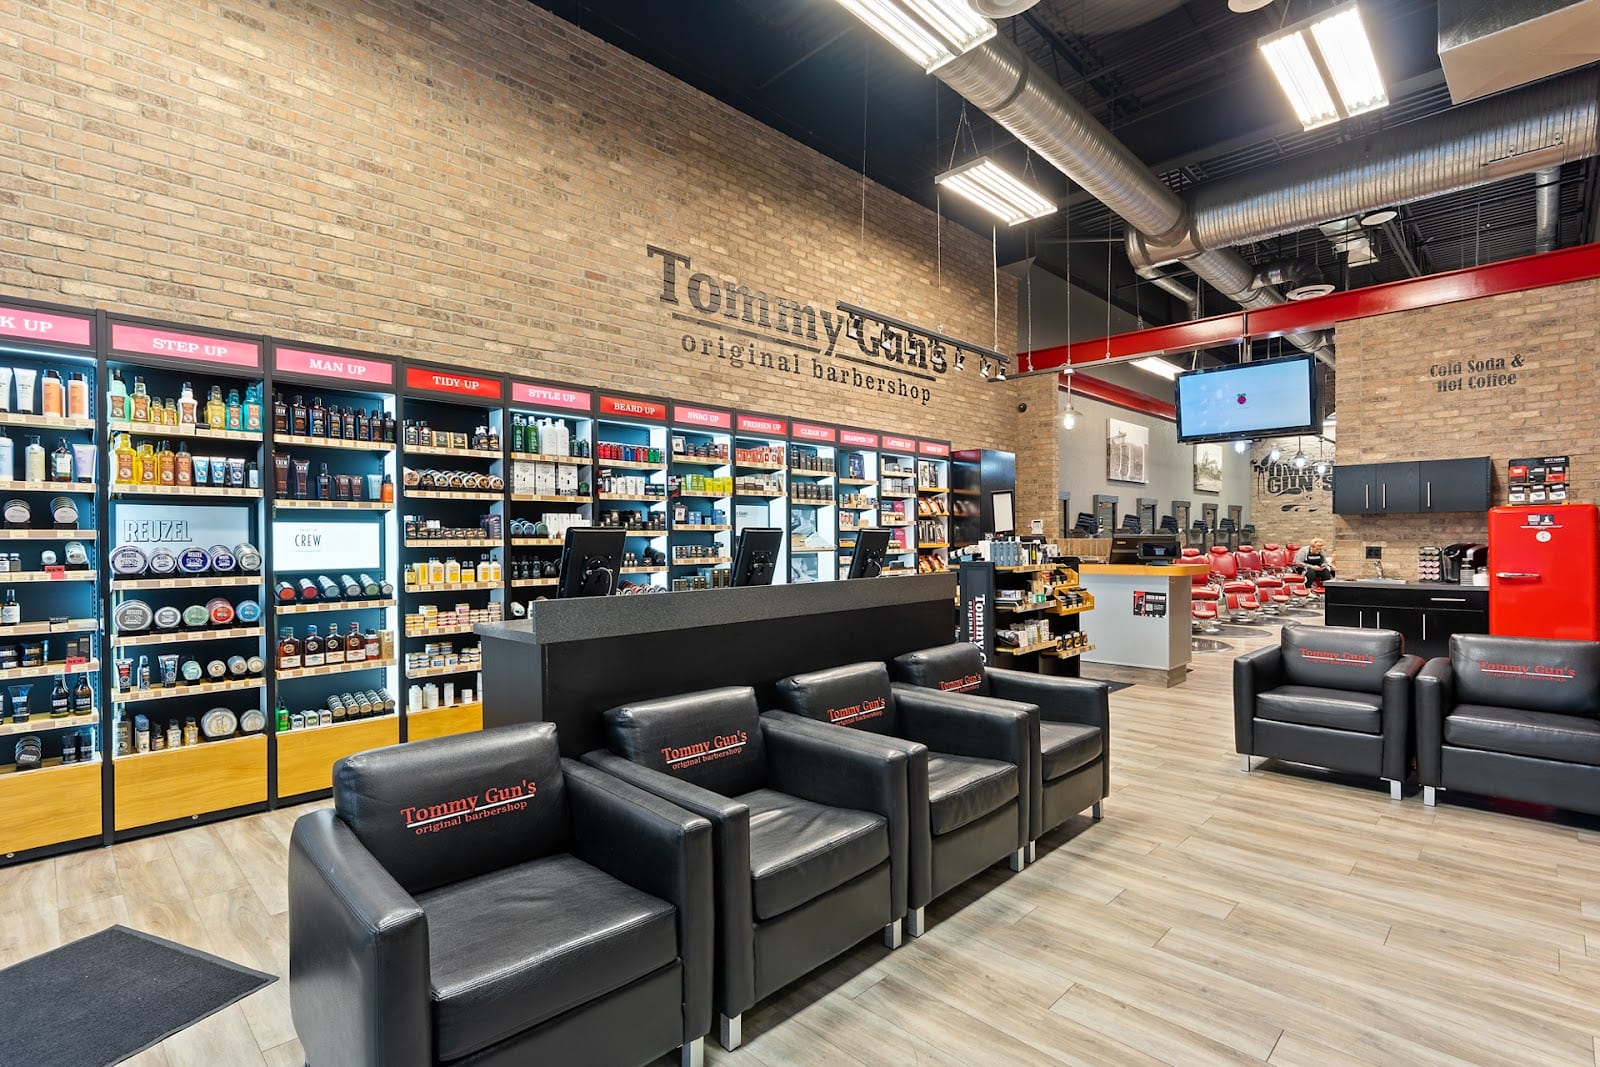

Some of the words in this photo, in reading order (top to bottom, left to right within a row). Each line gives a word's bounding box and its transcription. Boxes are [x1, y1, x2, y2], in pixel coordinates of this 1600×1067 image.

[646, 244, 844, 357] Tommy
[23, 320, 52, 332] UP
[152, 337, 199, 354] STEP
[204, 343, 228, 356] UP
[309, 358, 343, 372] MAN
[348, 364, 367, 375] UP
[680, 334, 801, 375] original
[811, 358, 931, 405] barbershop
[1430, 362, 1462, 378] Cold
[1468, 357, 1505, 373] Soda
[1510, 354, 1525, 369] &
[432, 376, 461, 386] TIDY
[463, 380, 480, 390] UP
[1437, 377, 1462, 392] Hot
[1468, 373, 1517, 390] Coffee
[528, 388, 561, 400] STYLE
[562, 394, 576, 403] UP
[614, 402, 643, 414] BEARD
[644, 406, 656, 415] UP
[688, 411, 708, 421] SWAG
[710, 414, 720, 423] UP
[772, 423, 782, 431] UP
[124, 520, 192, 543] REUZEL
[294, 534, 322, 547] CREW
[974, 594, 986, 650] Tommy
[1300, 647, 1339, 658] Tommy
[1480, 660, 1529, 673] Tommy
[1534, 665, 1576, 676] Gun's
[827, 704, 860, 720] Tommy
[862, 696, 886, 710] Gun's
[661, 741, 710, 761] Tommy
[714, 730, 748, 749] Gun's
[672, 757, 701, 770] original
[703, 746, 742, 762] barbershop
[400, 794, 478, 825] Tommy
[485, 779, 537, 803] Gun's
[416, 816, 461, 835] original
[465, 801, 528, 822] barbershop
